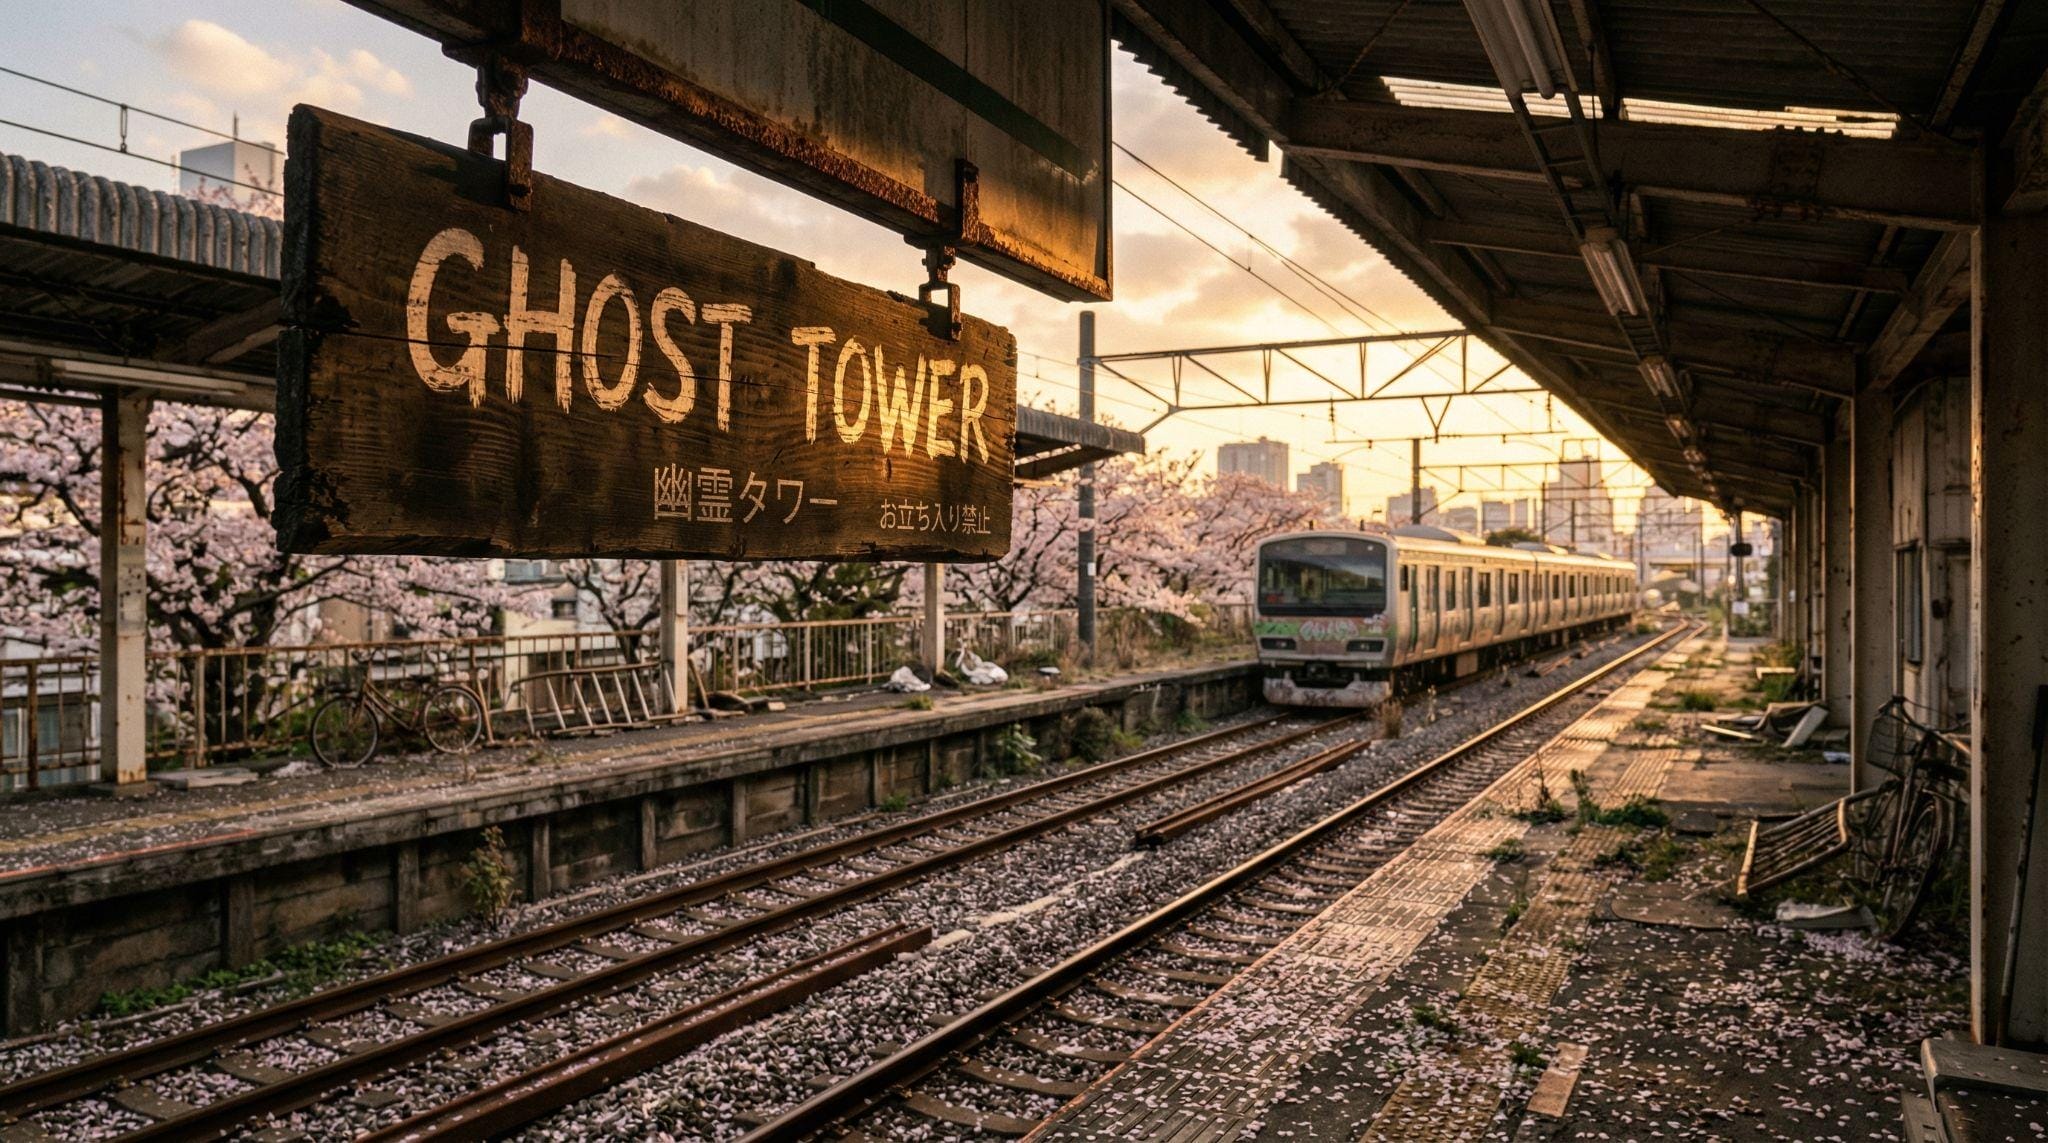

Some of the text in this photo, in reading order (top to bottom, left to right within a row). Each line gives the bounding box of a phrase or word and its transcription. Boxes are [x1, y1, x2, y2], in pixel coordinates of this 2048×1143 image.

[406, 227, 990, 464] GHOST TOWER
[654, 463, 837, 524] 幽霊タワー
[880, 498, 991, 534] お立ち入り禁止
